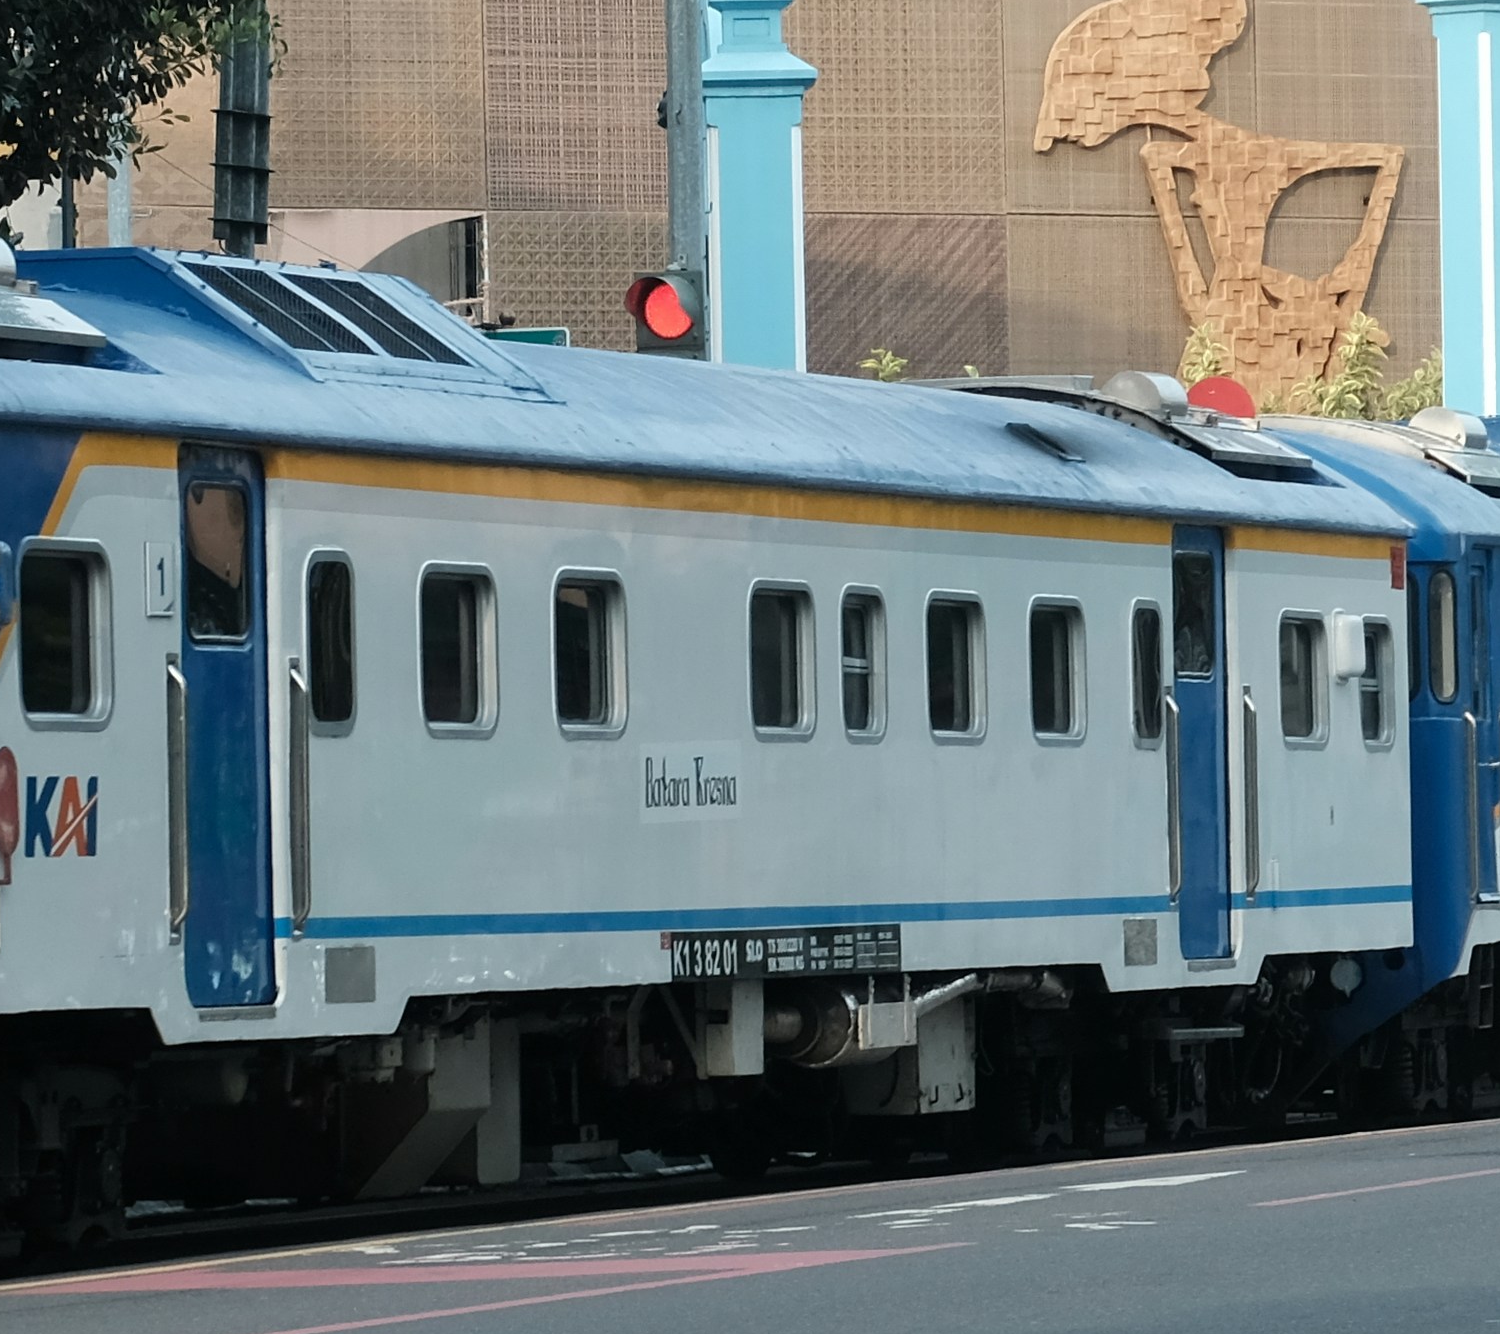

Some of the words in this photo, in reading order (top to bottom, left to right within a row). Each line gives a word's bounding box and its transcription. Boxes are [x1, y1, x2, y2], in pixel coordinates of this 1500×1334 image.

[157, 557, 165, 596] 1
[645, 756, 690, 808] Batara
[25, 776, 98, 857] KAI
[672, 940, 690, 977] K1
[694, 939, 702, 977] 3
[704, 939, 721, 977] 82
[723, 938, 738, 975] 01
[746, 939, 763, 962] SLO
